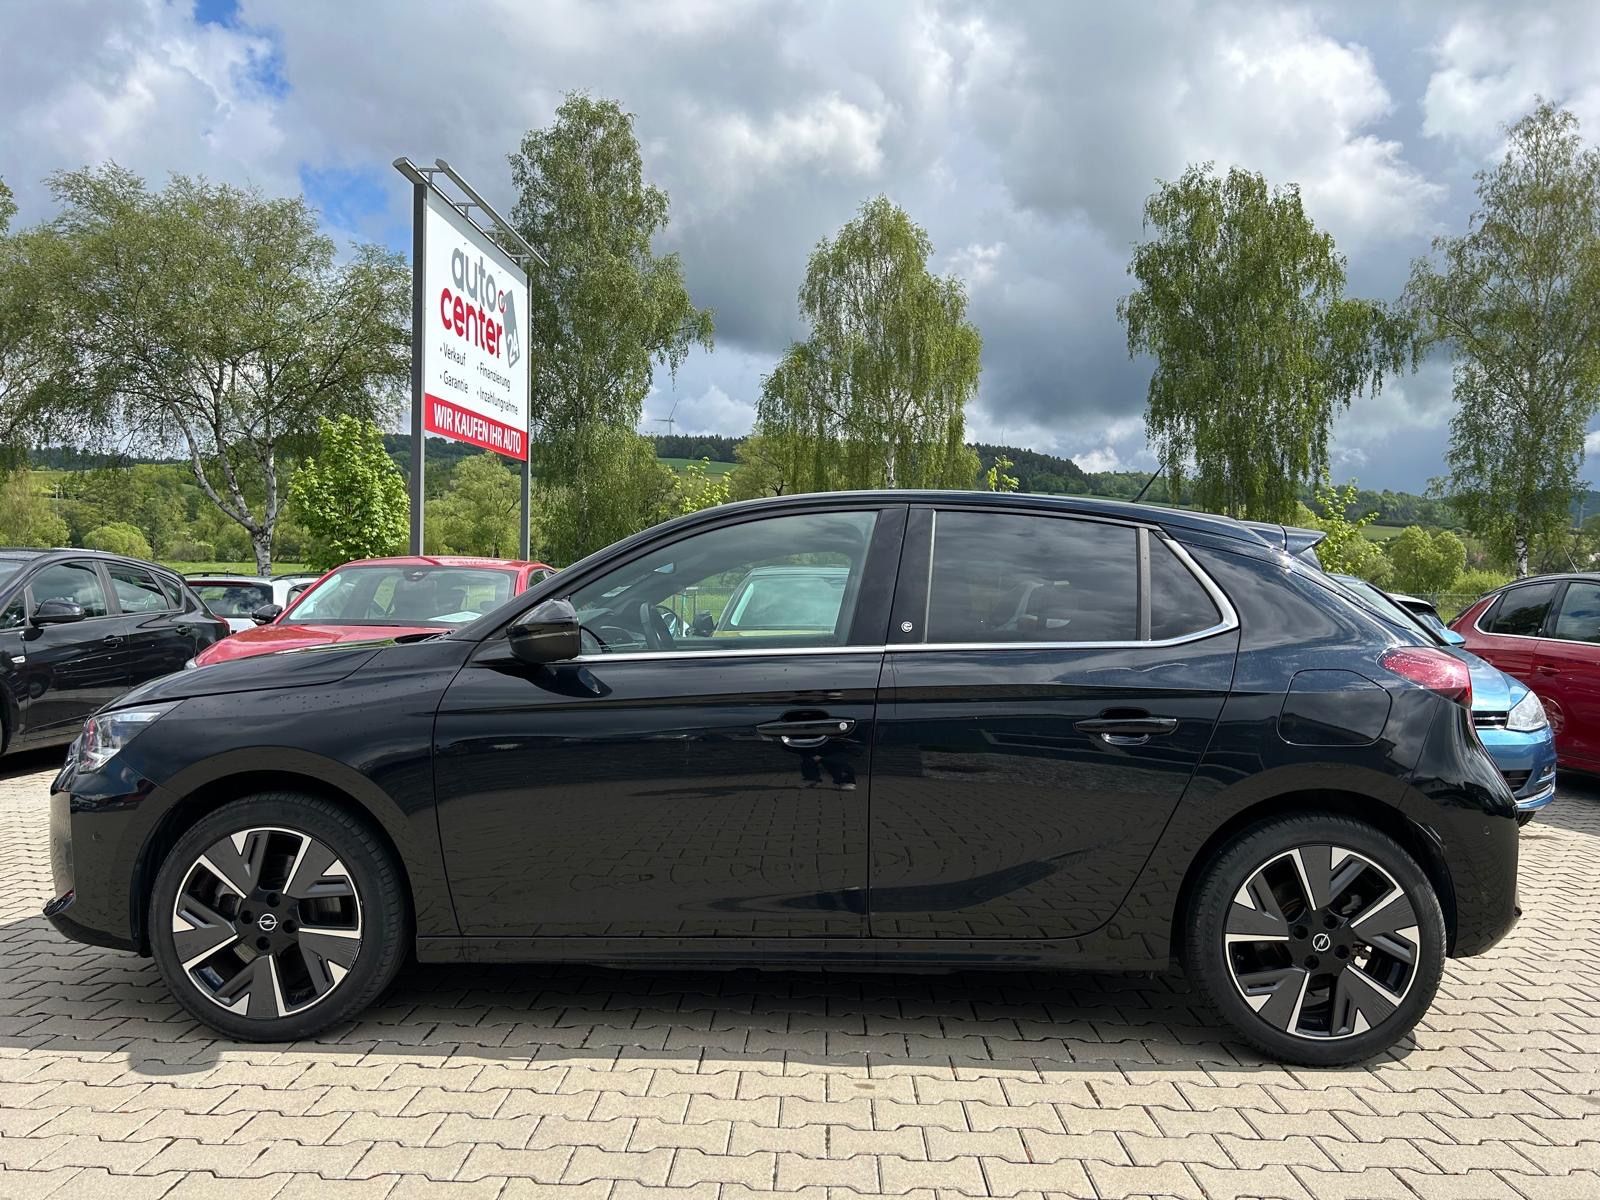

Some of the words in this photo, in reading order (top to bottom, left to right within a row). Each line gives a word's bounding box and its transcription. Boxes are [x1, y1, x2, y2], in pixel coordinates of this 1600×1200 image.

[452, 248, 497, 313] auto
[440, 288, 502, 359] center
[443, 342, 466, 366] Verkauf
[507, 329, 519, 361] 24
[443, 370, 468, 394] Garantie
[480, 362, 511, 392] Finanzierung
[480, 387, 518, 415] Inzahlungnahme
[434, 403, 453, 431] WIR
[455, 411, 489, 443] KAUFEN
[490, 424, 503, 443] IHR
[503, 428, 521, 454] AUTO
